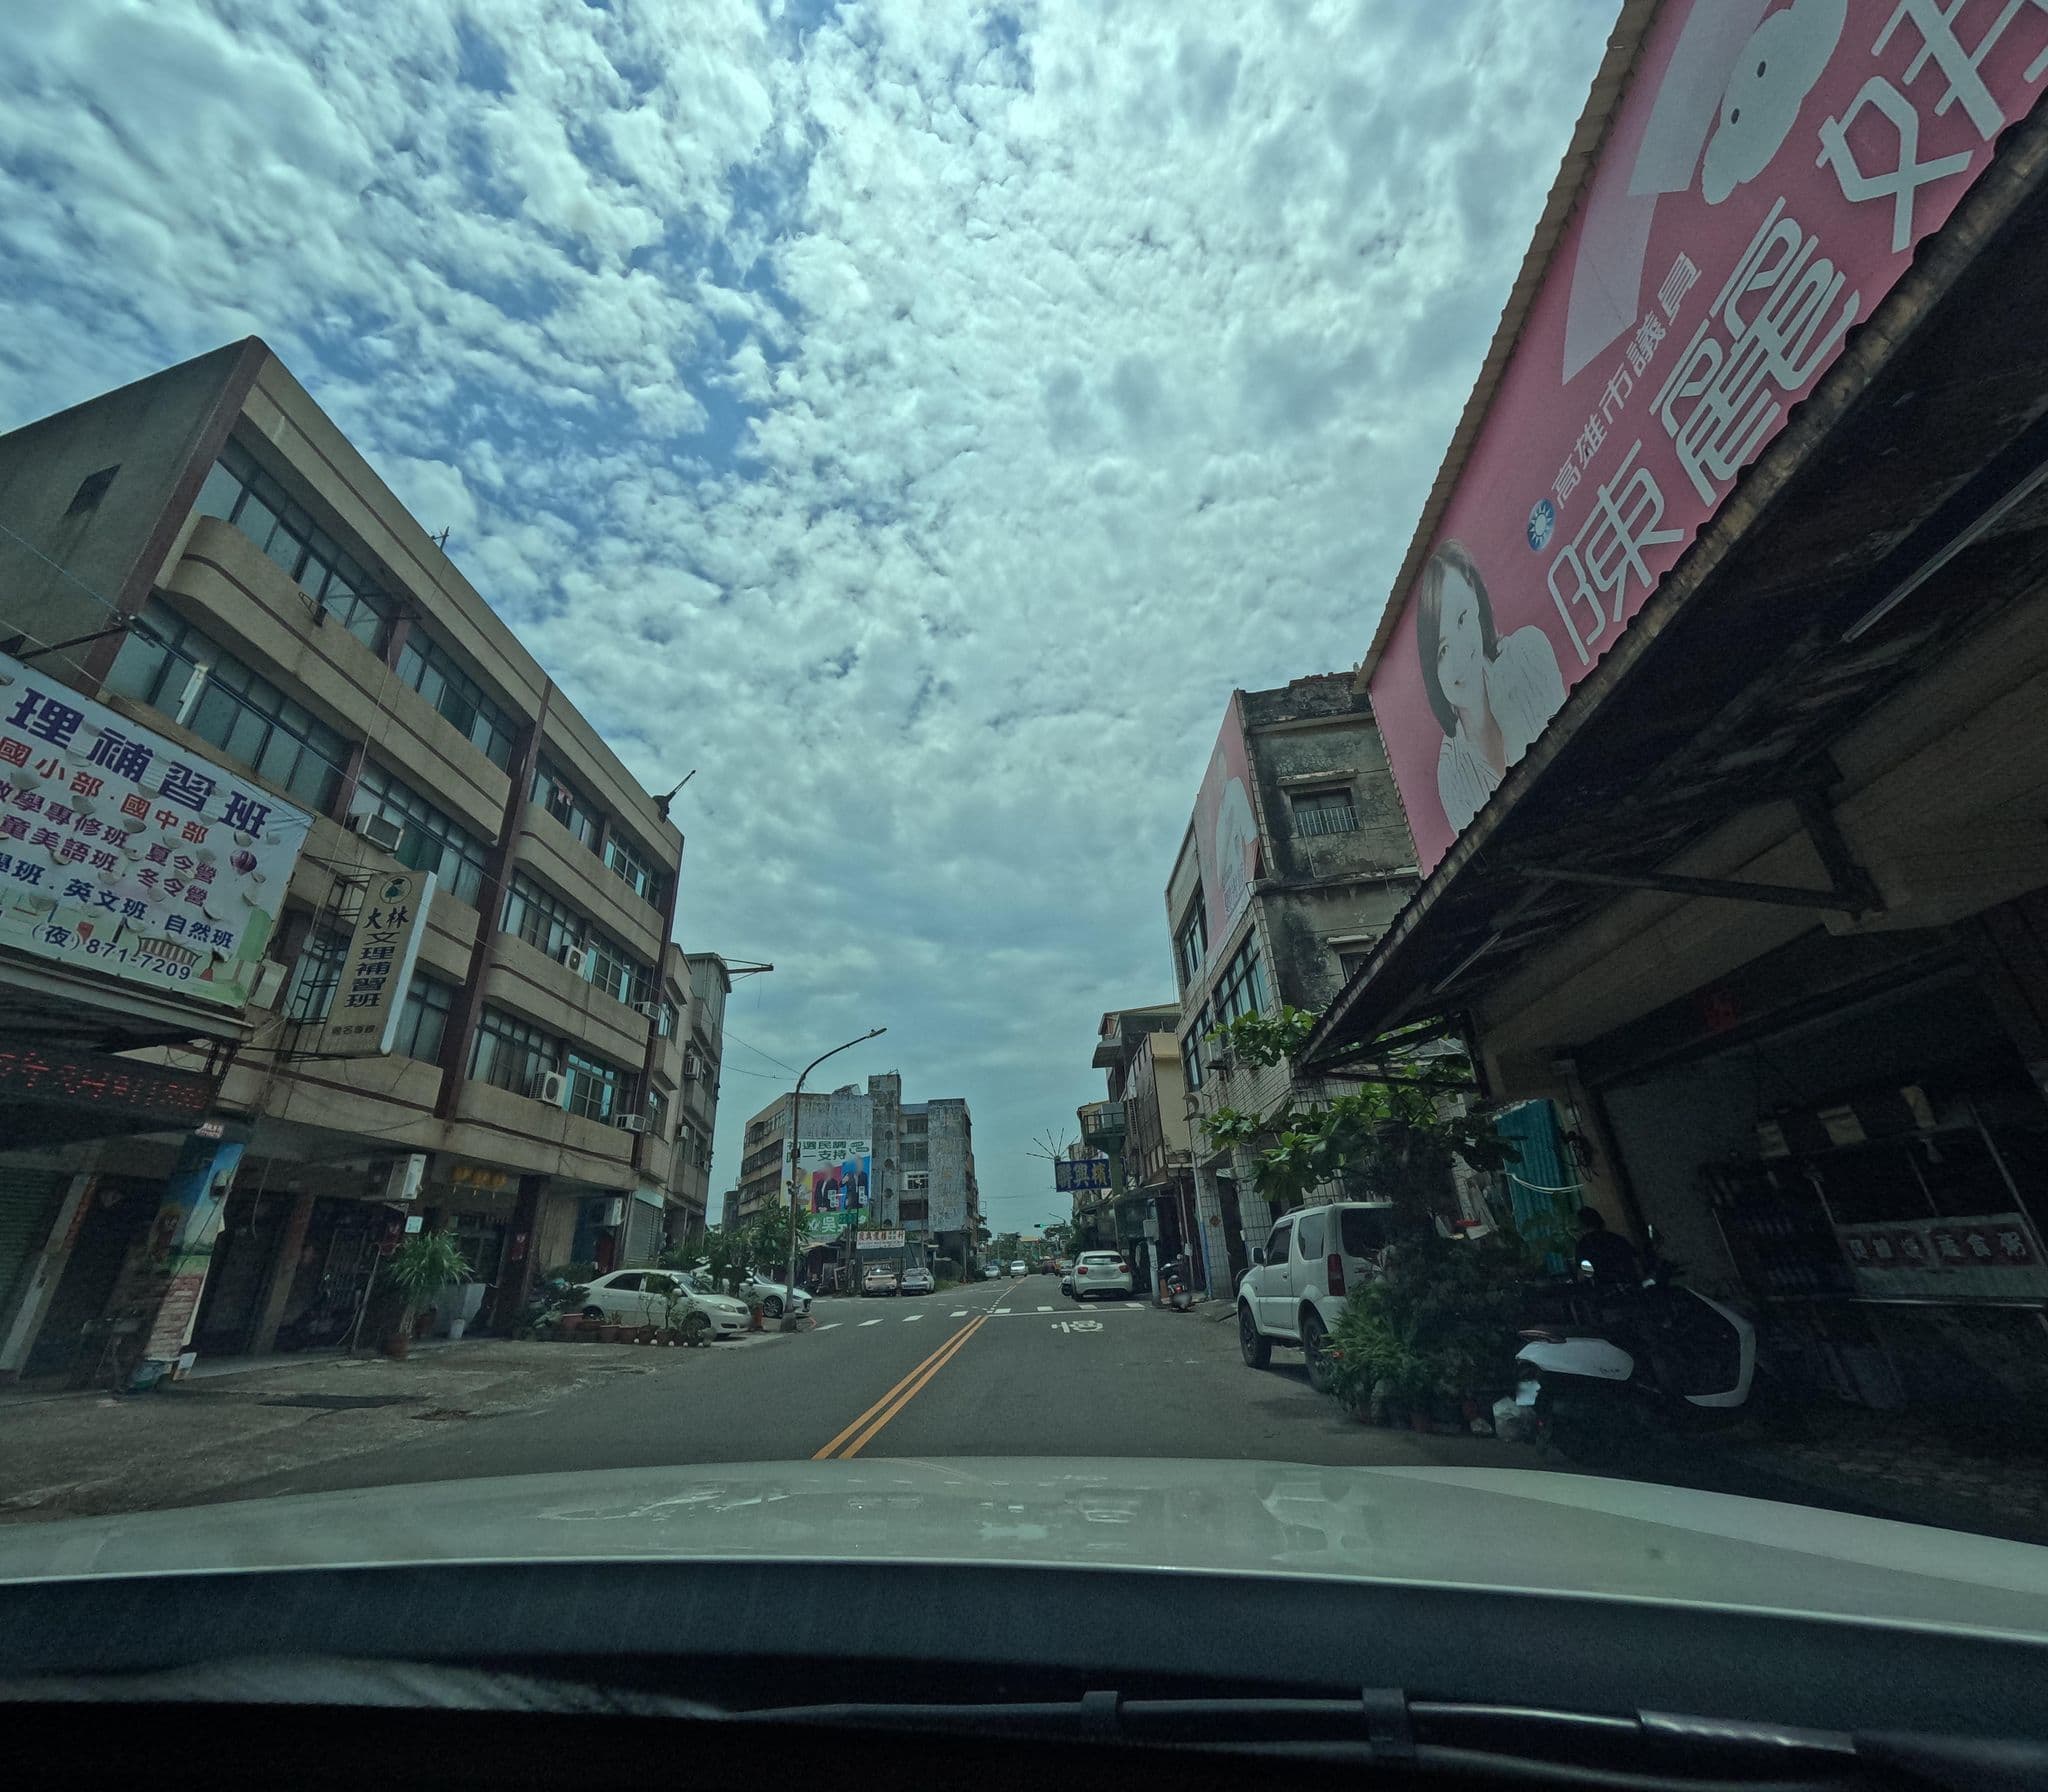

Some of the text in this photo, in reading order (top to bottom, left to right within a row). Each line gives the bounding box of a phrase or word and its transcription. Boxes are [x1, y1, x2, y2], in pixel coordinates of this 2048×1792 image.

[1551, 251, 1702, 509] 高雄市議員
[5, 687, 272, 839] 理補習班
[344, 931, 401, 1008] 文理補習班
[363, 906, 409, 929] 大林
